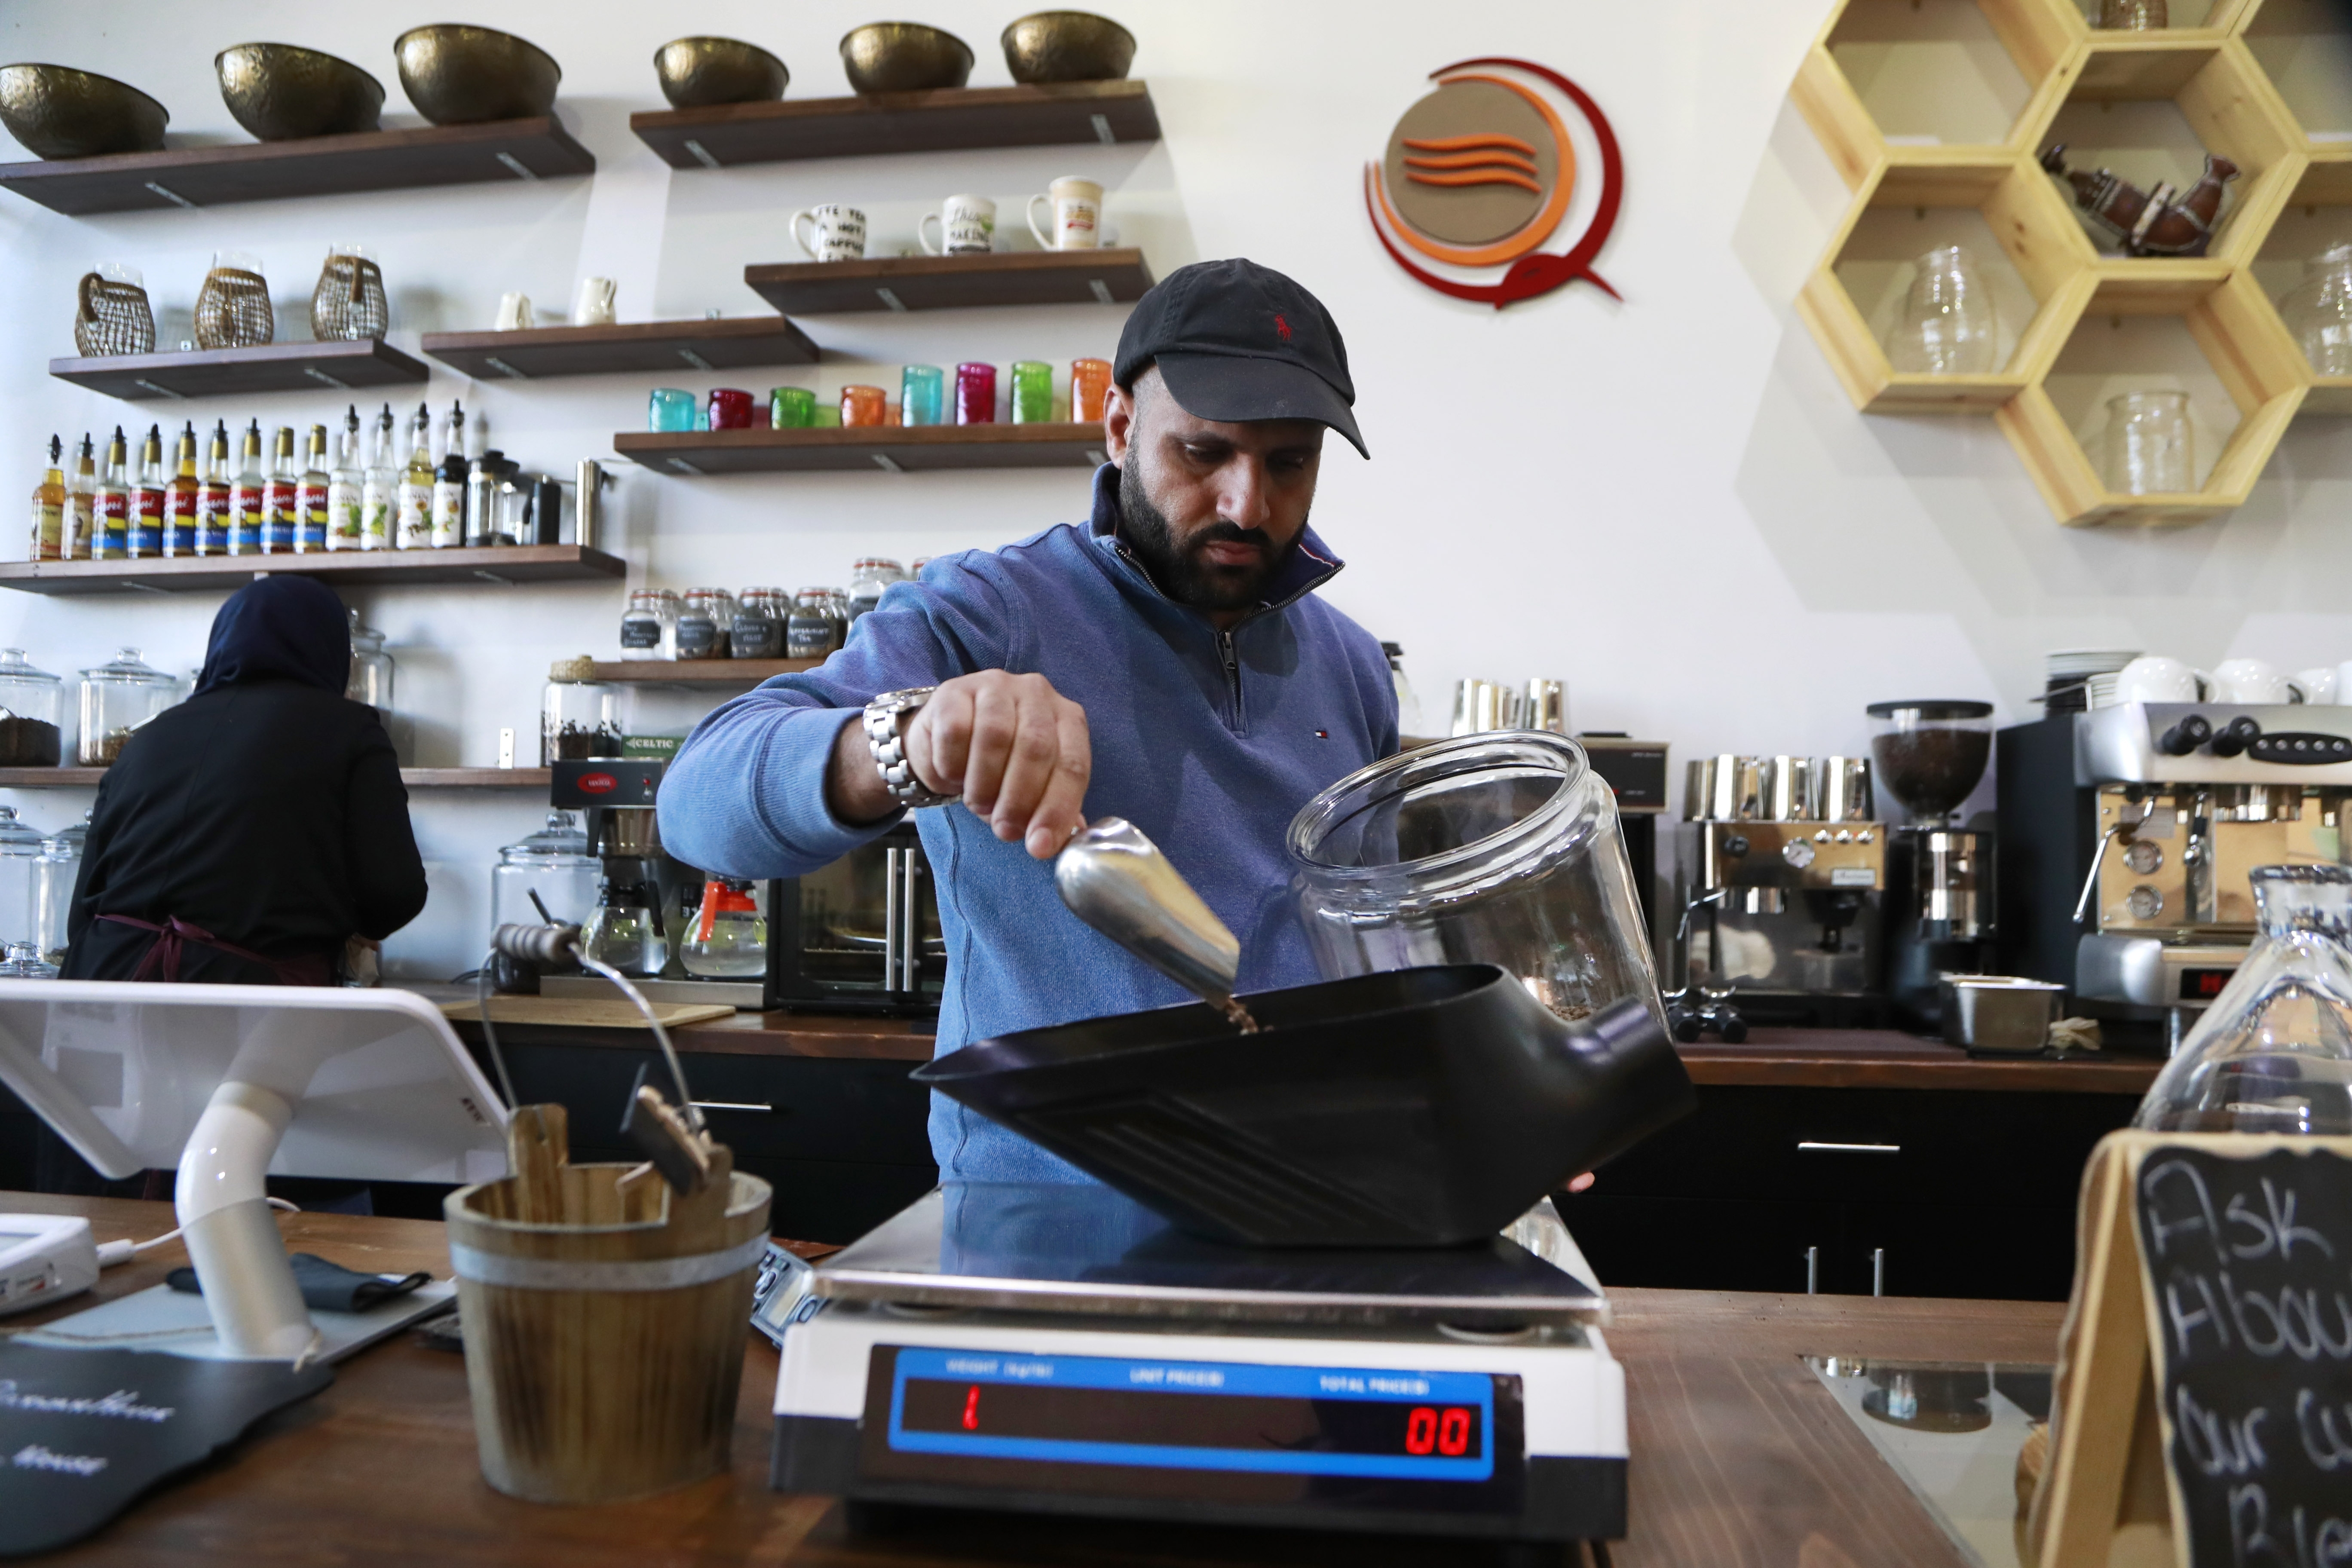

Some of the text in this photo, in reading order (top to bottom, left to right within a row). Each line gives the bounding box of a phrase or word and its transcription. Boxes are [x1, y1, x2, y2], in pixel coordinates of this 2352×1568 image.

[635, 738, 673, 749] CELTIC
[2143, 1159, 2337, 1266] Ask
[1129, 1367, 1164, 1384] UNIT
[1320, 1375, 1365, 1393] TOTAL
[1405, 1407, 1471, 1456] 00
